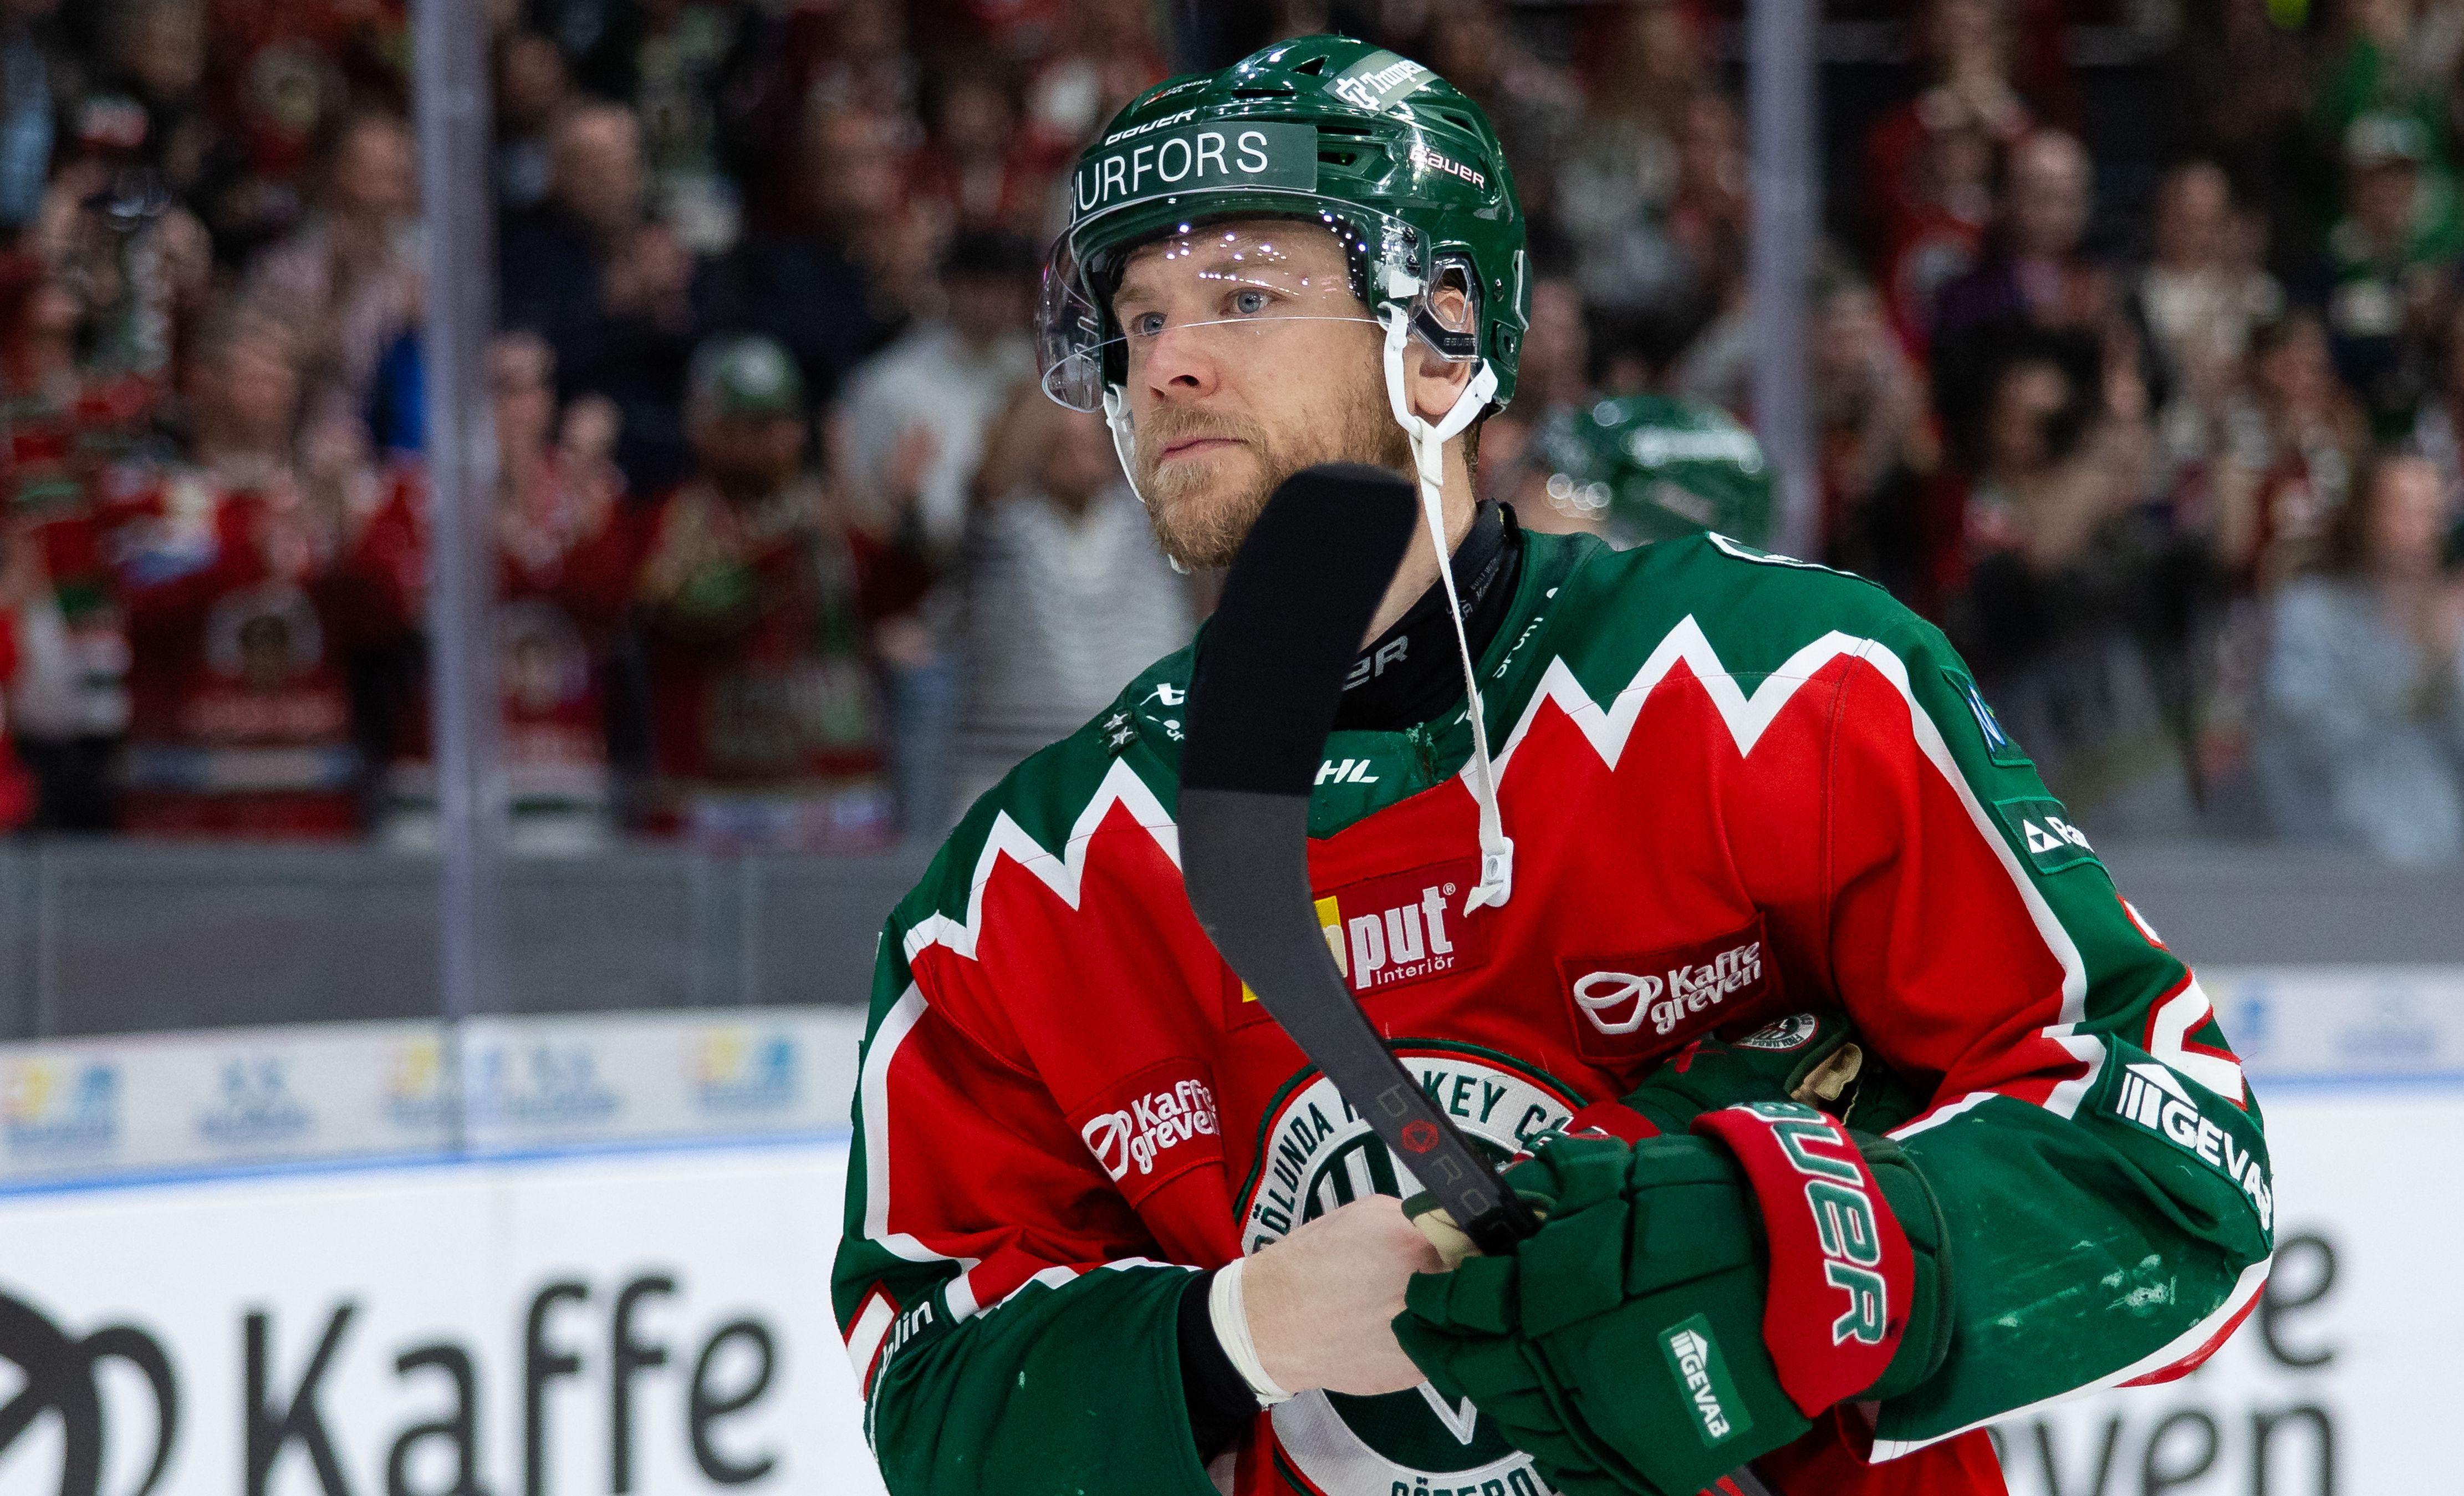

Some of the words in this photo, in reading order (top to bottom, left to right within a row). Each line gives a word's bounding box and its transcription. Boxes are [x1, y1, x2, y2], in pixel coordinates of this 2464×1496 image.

[1313, 759, 1380, 785] HL
[1651, 959, 1761, 1036] greven
[1668, 942, 1759, 998] Kaffe
[1131, 1079, 1217, 1133] Kaffe
[1250, 1102, 1335, 1255] ÖLUNDA
[241, 1268, 777, 1496] Kaffe
[1681, 1352, 1731, 1438] GEVAB
